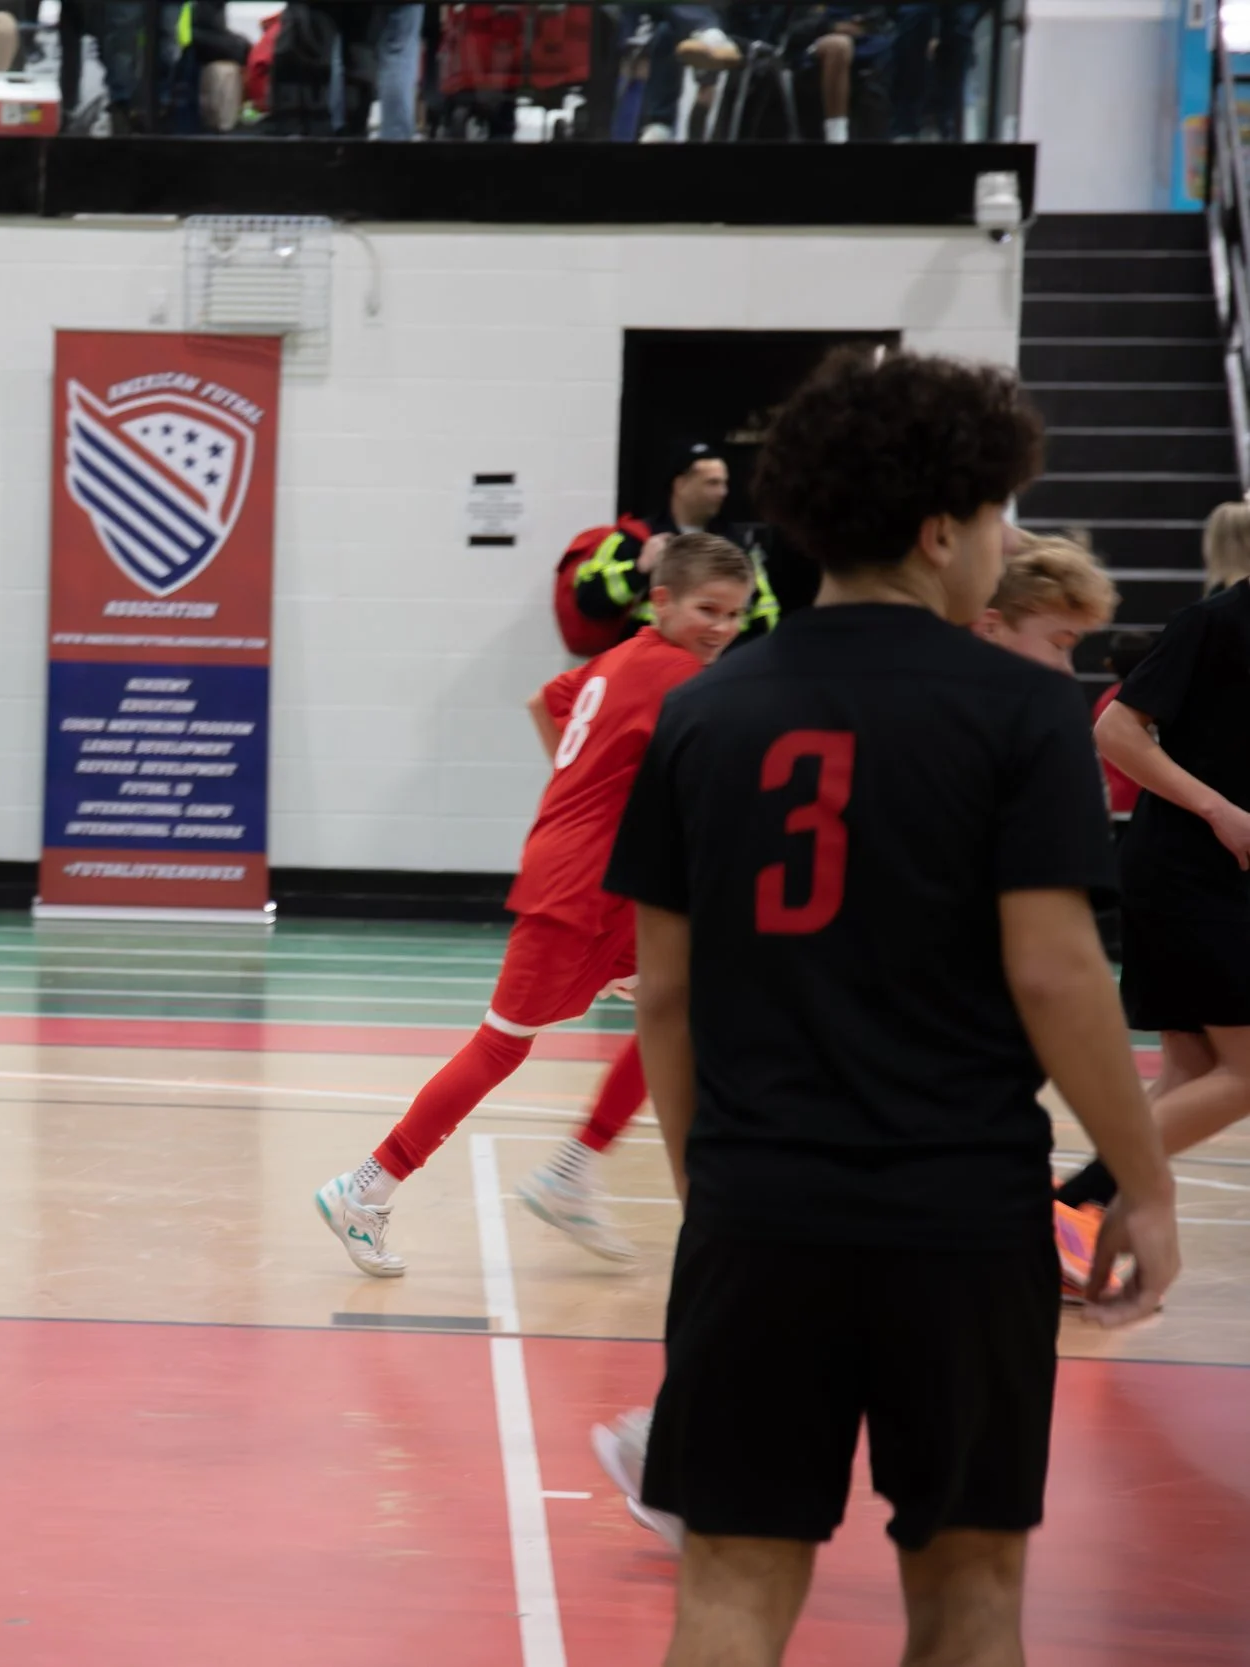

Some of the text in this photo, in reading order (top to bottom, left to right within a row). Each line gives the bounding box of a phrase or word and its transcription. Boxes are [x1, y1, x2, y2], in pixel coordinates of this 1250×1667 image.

[107, 372, 264, 423] AMERICAN FUTSAL
[103, 600, 219, 618] ASSOCIATION
[125, 678, 191, 692] ACADEMY
[119, 698, 196, 713] EDUCATION
[187, 722, 255, 735] PROGRAM
[555, 676, 606, 769] 8
[135, 741, 234, 755] DEVELOPMENT
[139, 762, 237, 776] DEVELOPMENT
[119, 781, 171, 795] FUTSAL
[77, 801, 183, 816] INTERNATIONAL
[65, 822, 170, 837] INTERNATIONAL
[755, 729, 856, 934] 3
